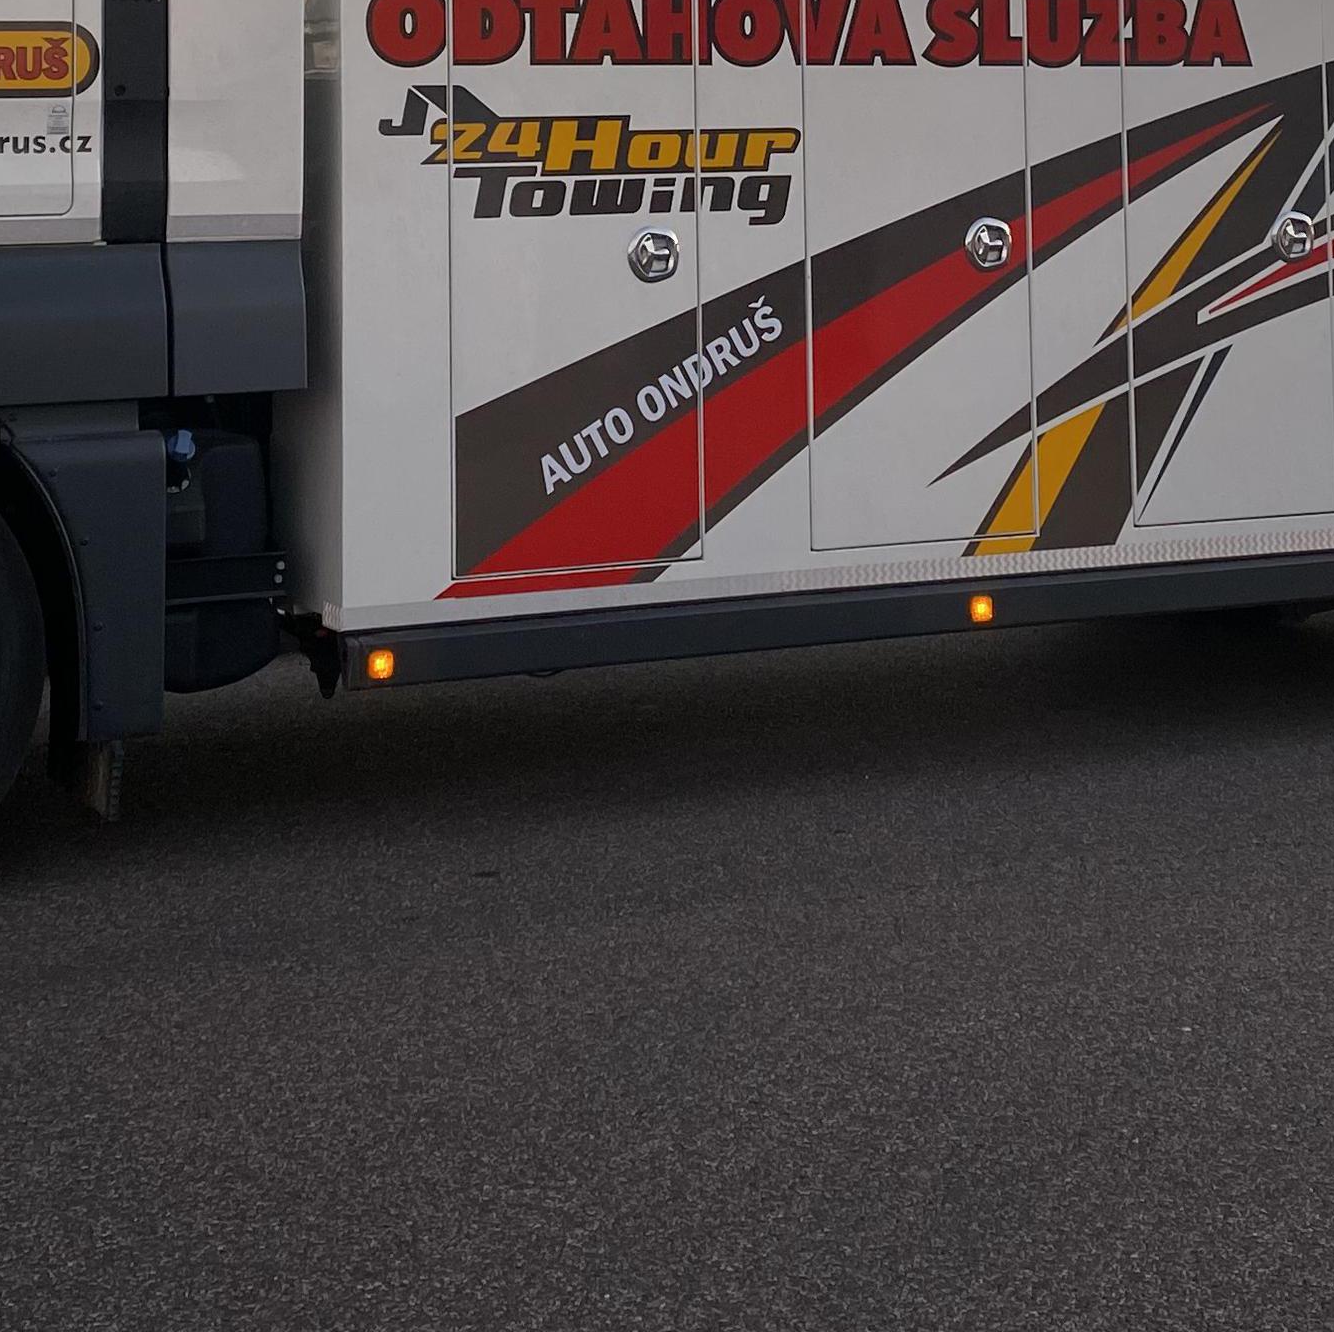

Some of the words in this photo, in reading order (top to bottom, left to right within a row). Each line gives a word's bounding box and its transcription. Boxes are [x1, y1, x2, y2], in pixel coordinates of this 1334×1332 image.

[453, 166, 793, 226] Towing
[539, 405, 635, 496] AUTO
[635, 294, 785, 424] ONDRUŠ
